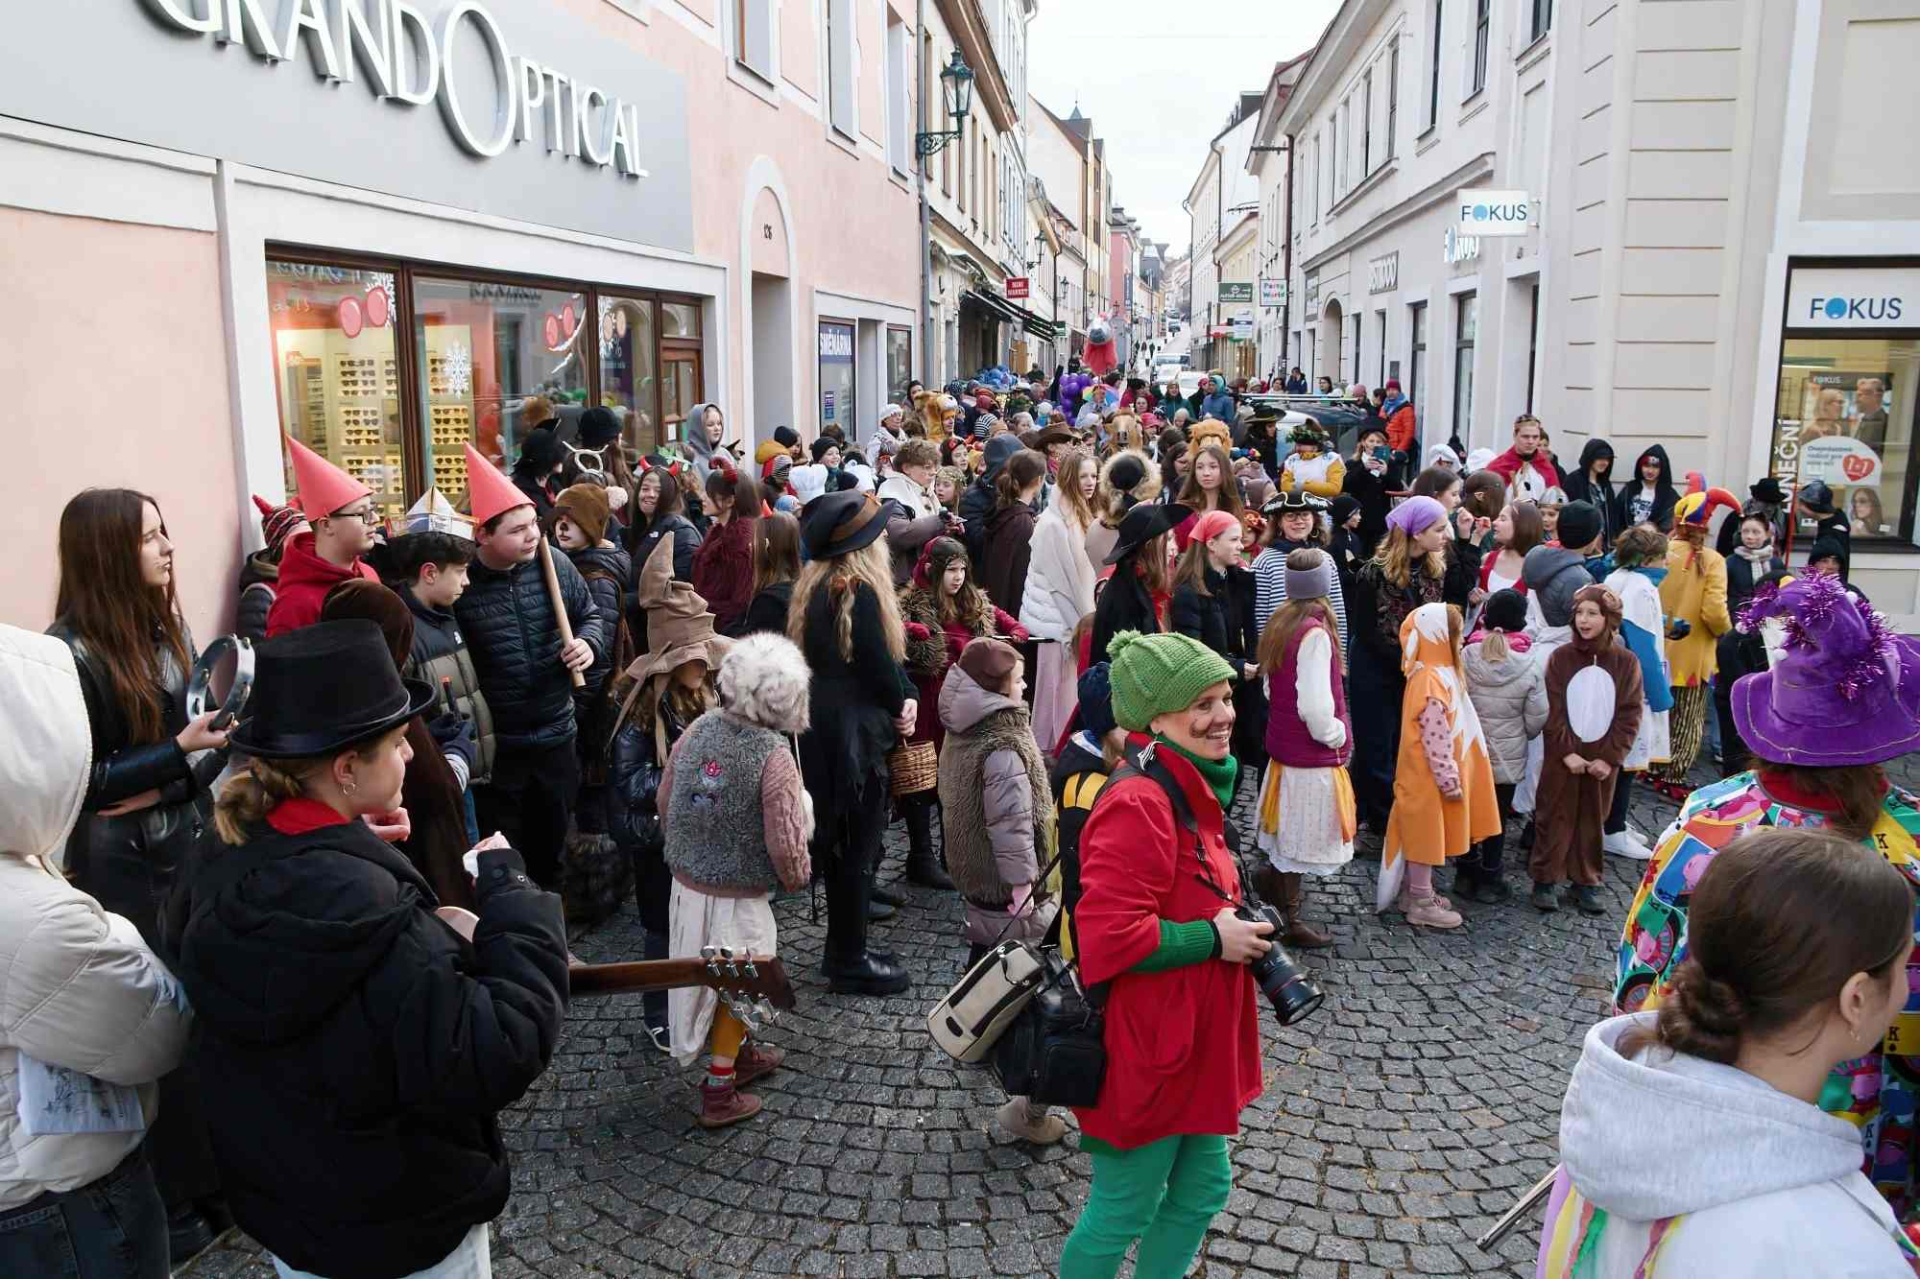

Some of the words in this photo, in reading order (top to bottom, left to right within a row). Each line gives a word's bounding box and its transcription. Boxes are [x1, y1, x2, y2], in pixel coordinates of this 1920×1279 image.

[1461, 204, 1527, 222] FOKUS
[1809, 297, 1903, 320] FOKUS
[1775, 418, 1802, 514] LUNEČNÍ
[1875, 833, 1889, 849] K
[1888, 1026, 1900, 1041] K
[1865, 1123, 1875, 1139] K
